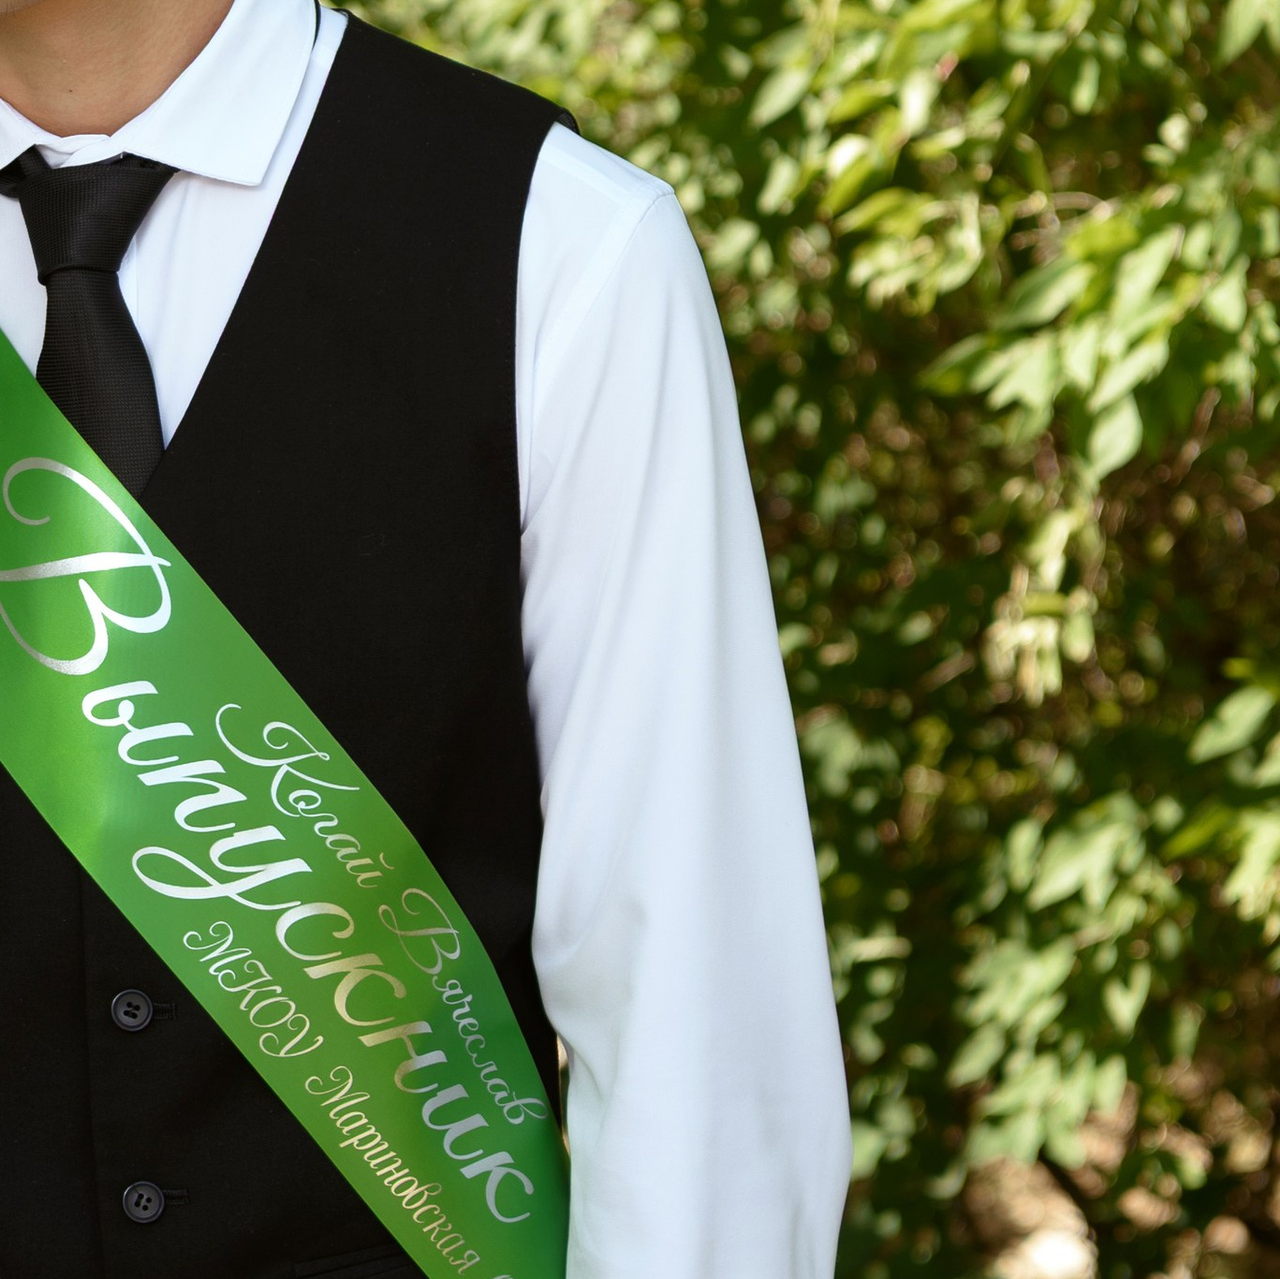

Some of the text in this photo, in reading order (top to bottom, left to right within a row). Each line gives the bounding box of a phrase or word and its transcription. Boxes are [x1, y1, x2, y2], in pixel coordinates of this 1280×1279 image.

[182, 920, 324, 1058] МКОУ
[304, 1064, 481, 1275] Мариновская
[214, 702, 549, 1125] Когай Вячеслав
